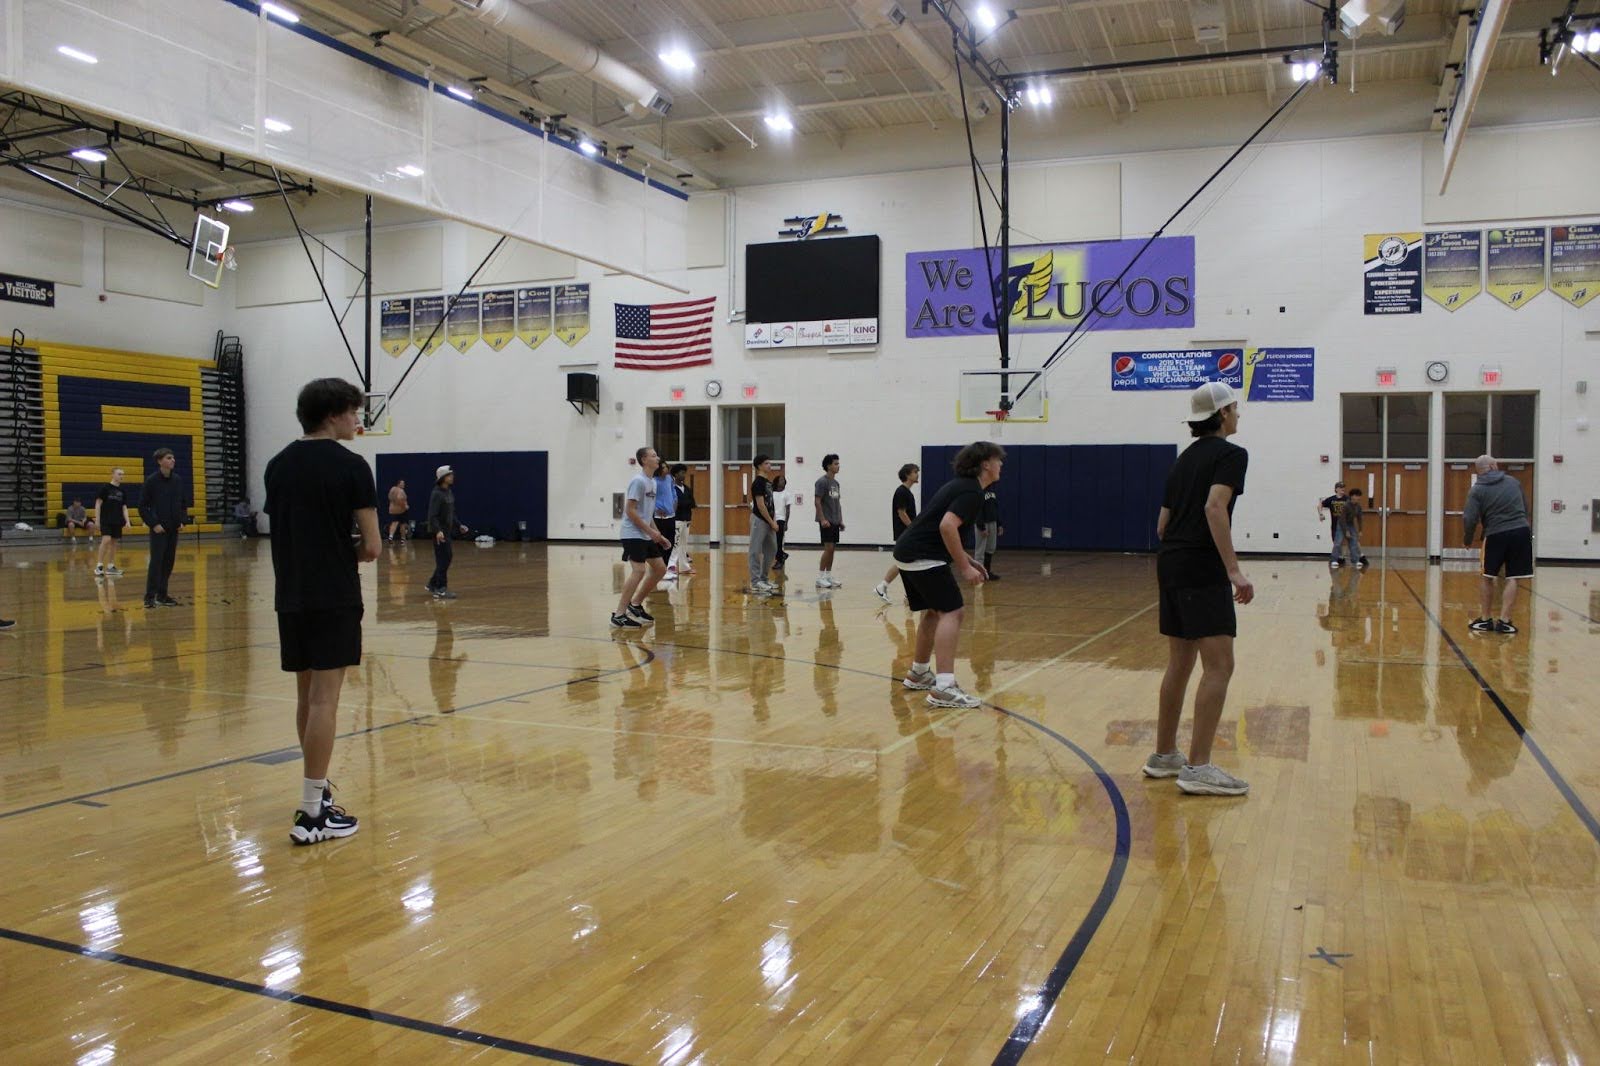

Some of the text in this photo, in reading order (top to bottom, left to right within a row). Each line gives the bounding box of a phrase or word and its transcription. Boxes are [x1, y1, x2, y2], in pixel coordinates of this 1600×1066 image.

[918, 259, 973, 292] We
[5, 282, 47, 301] VISITORS
[912, 298, 976, 329] Are
[853, 326, 876, 334] KING
[1114, 378, 1137, 387] pepsi
[1165, 375, 1210, 383] CHAMPIONS
